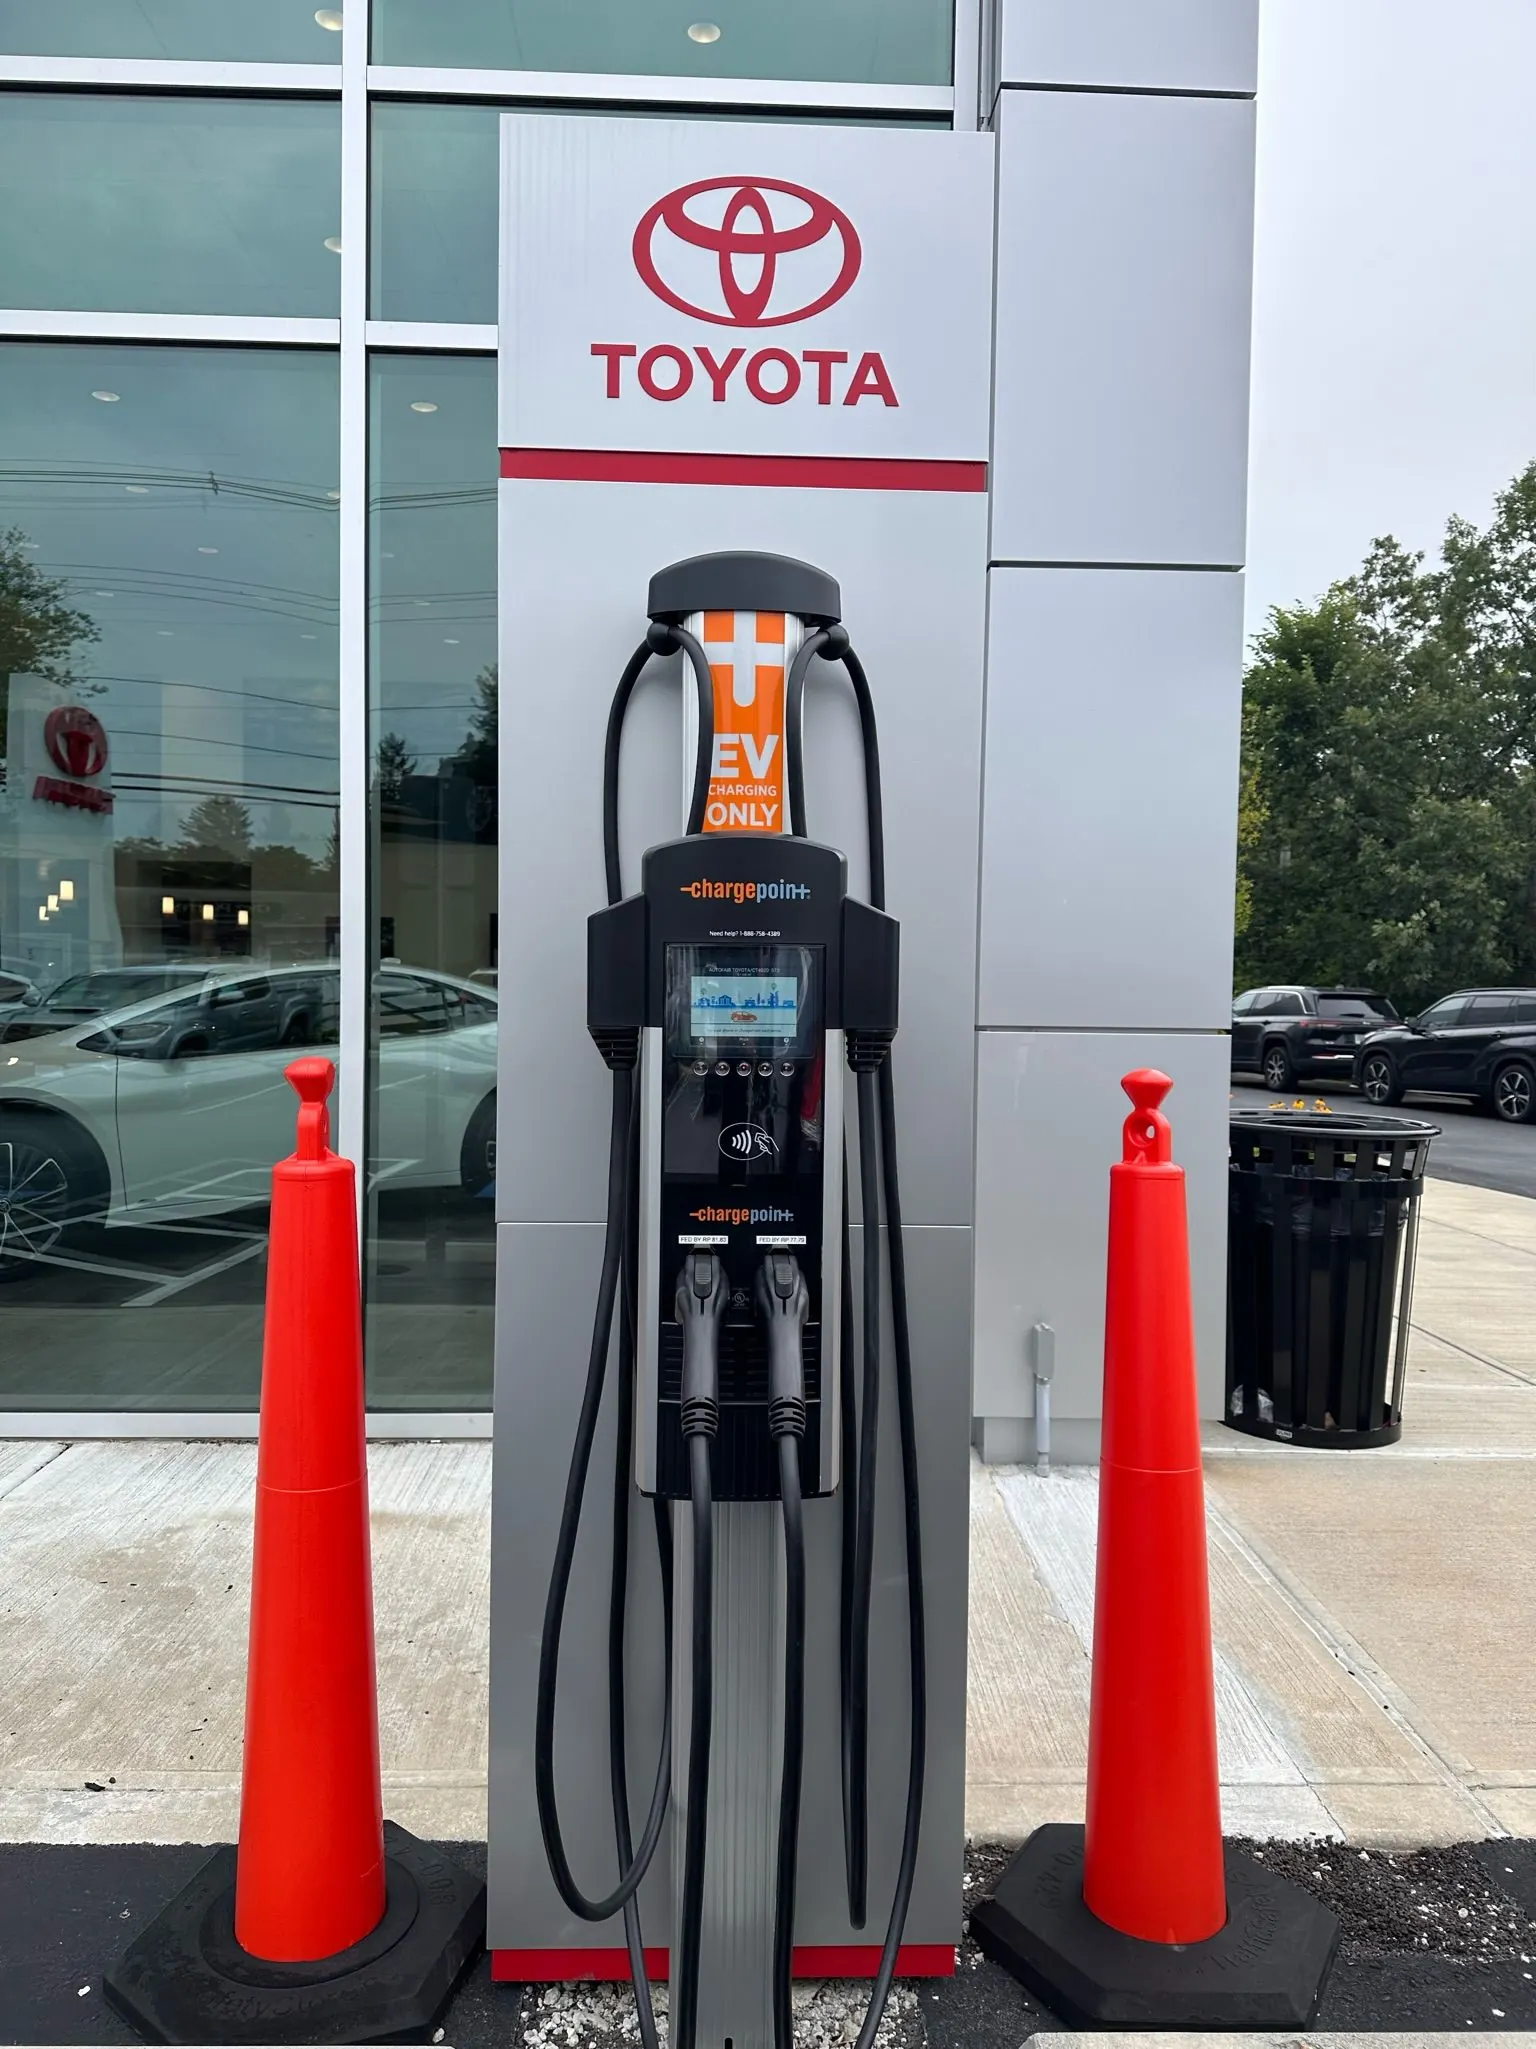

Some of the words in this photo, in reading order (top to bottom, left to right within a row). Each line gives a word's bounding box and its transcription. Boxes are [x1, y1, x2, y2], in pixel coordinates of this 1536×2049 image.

[590, 343, 900, 407] TOYOTA
[710, 733, 779, 779] EV
[708, 784, 777, 796] CHARGING
[707, 802, 779, 827] ONLY
[725, 930, 739, 938] help?
